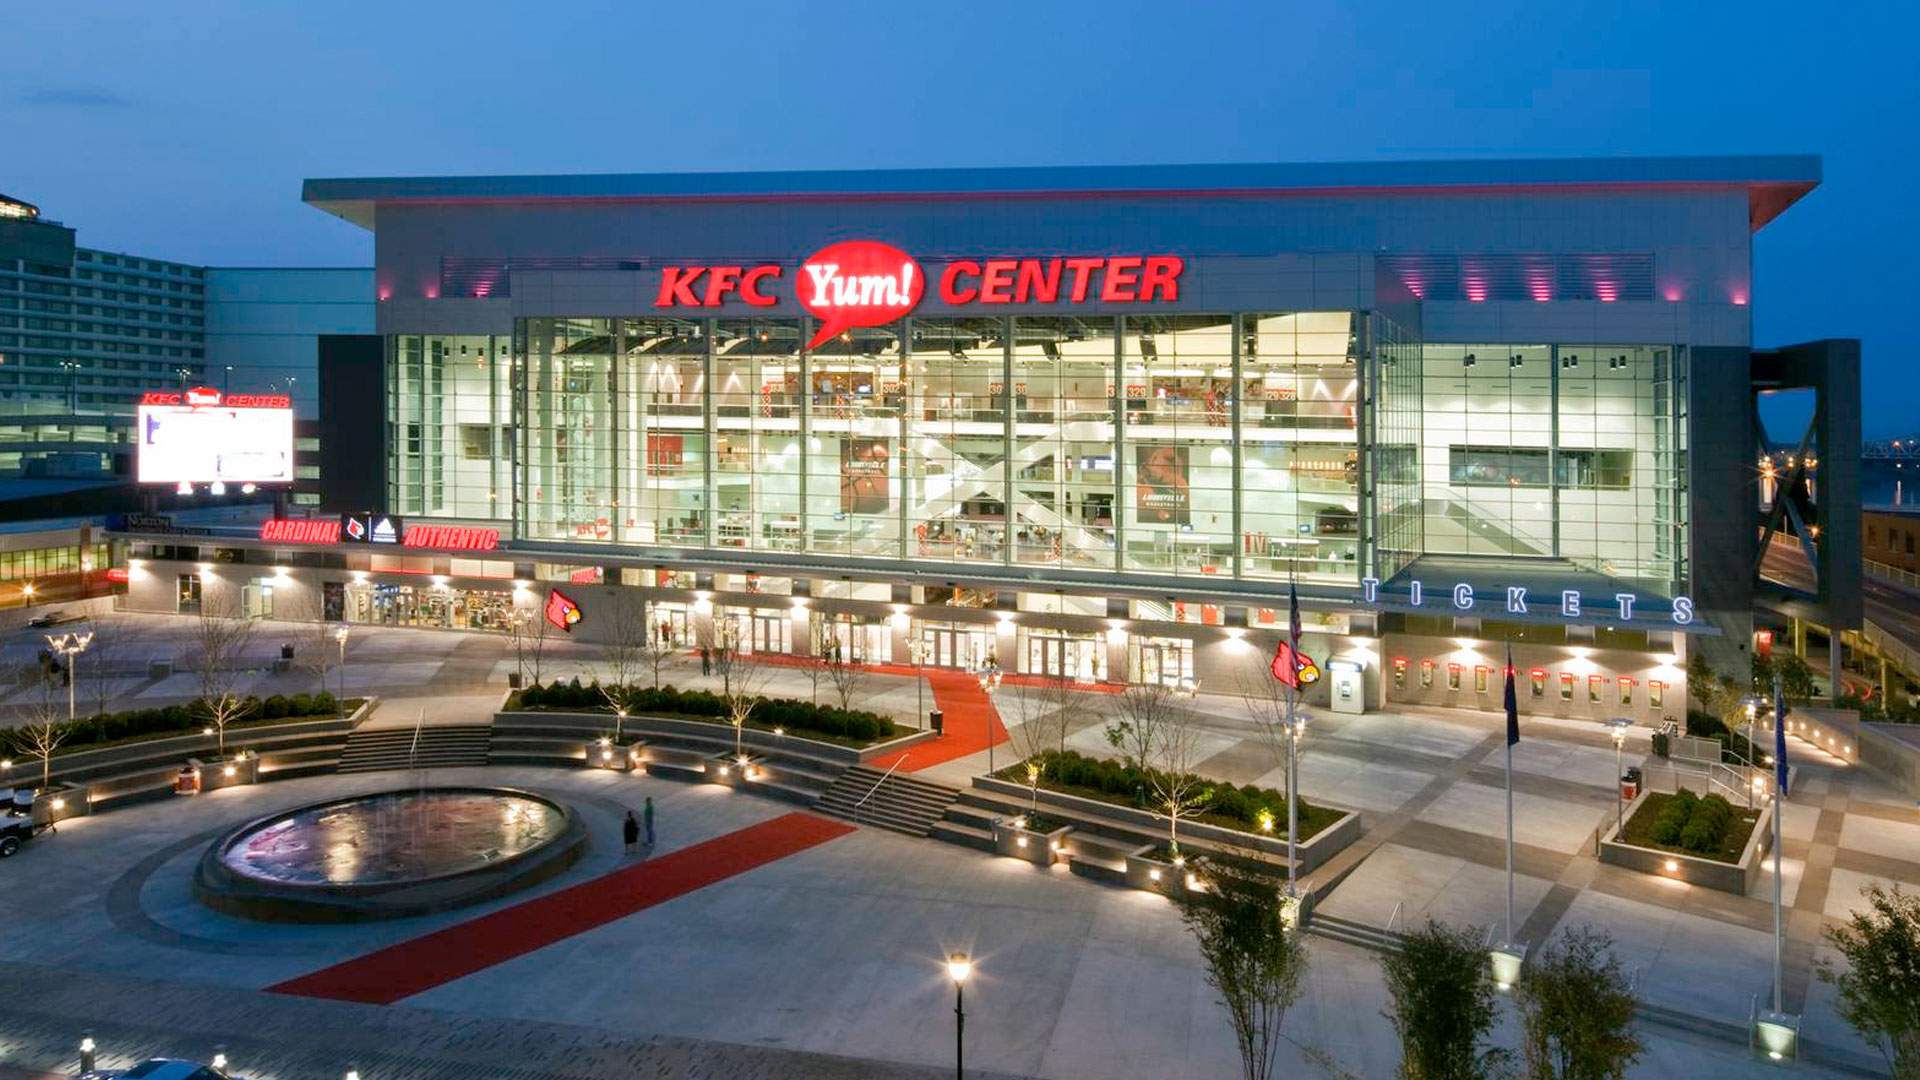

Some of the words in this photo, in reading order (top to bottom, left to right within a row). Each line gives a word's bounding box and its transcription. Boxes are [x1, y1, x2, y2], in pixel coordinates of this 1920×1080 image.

[654, 265, 780, 306] KFC
[805, 262, 913, 306] Yum!
[939, 256, 1183, 304] CENTER
[143, 394, 181, 405] KFC
[226, 396, 290, 408] CENTER
[1128, 387, 1146, 397] 329
[261, 520, 340, 543] CARDINAL
[403, 526, 498, 550] AUTHENTIC
[1362, 578, 1694, 624] TICKETS
